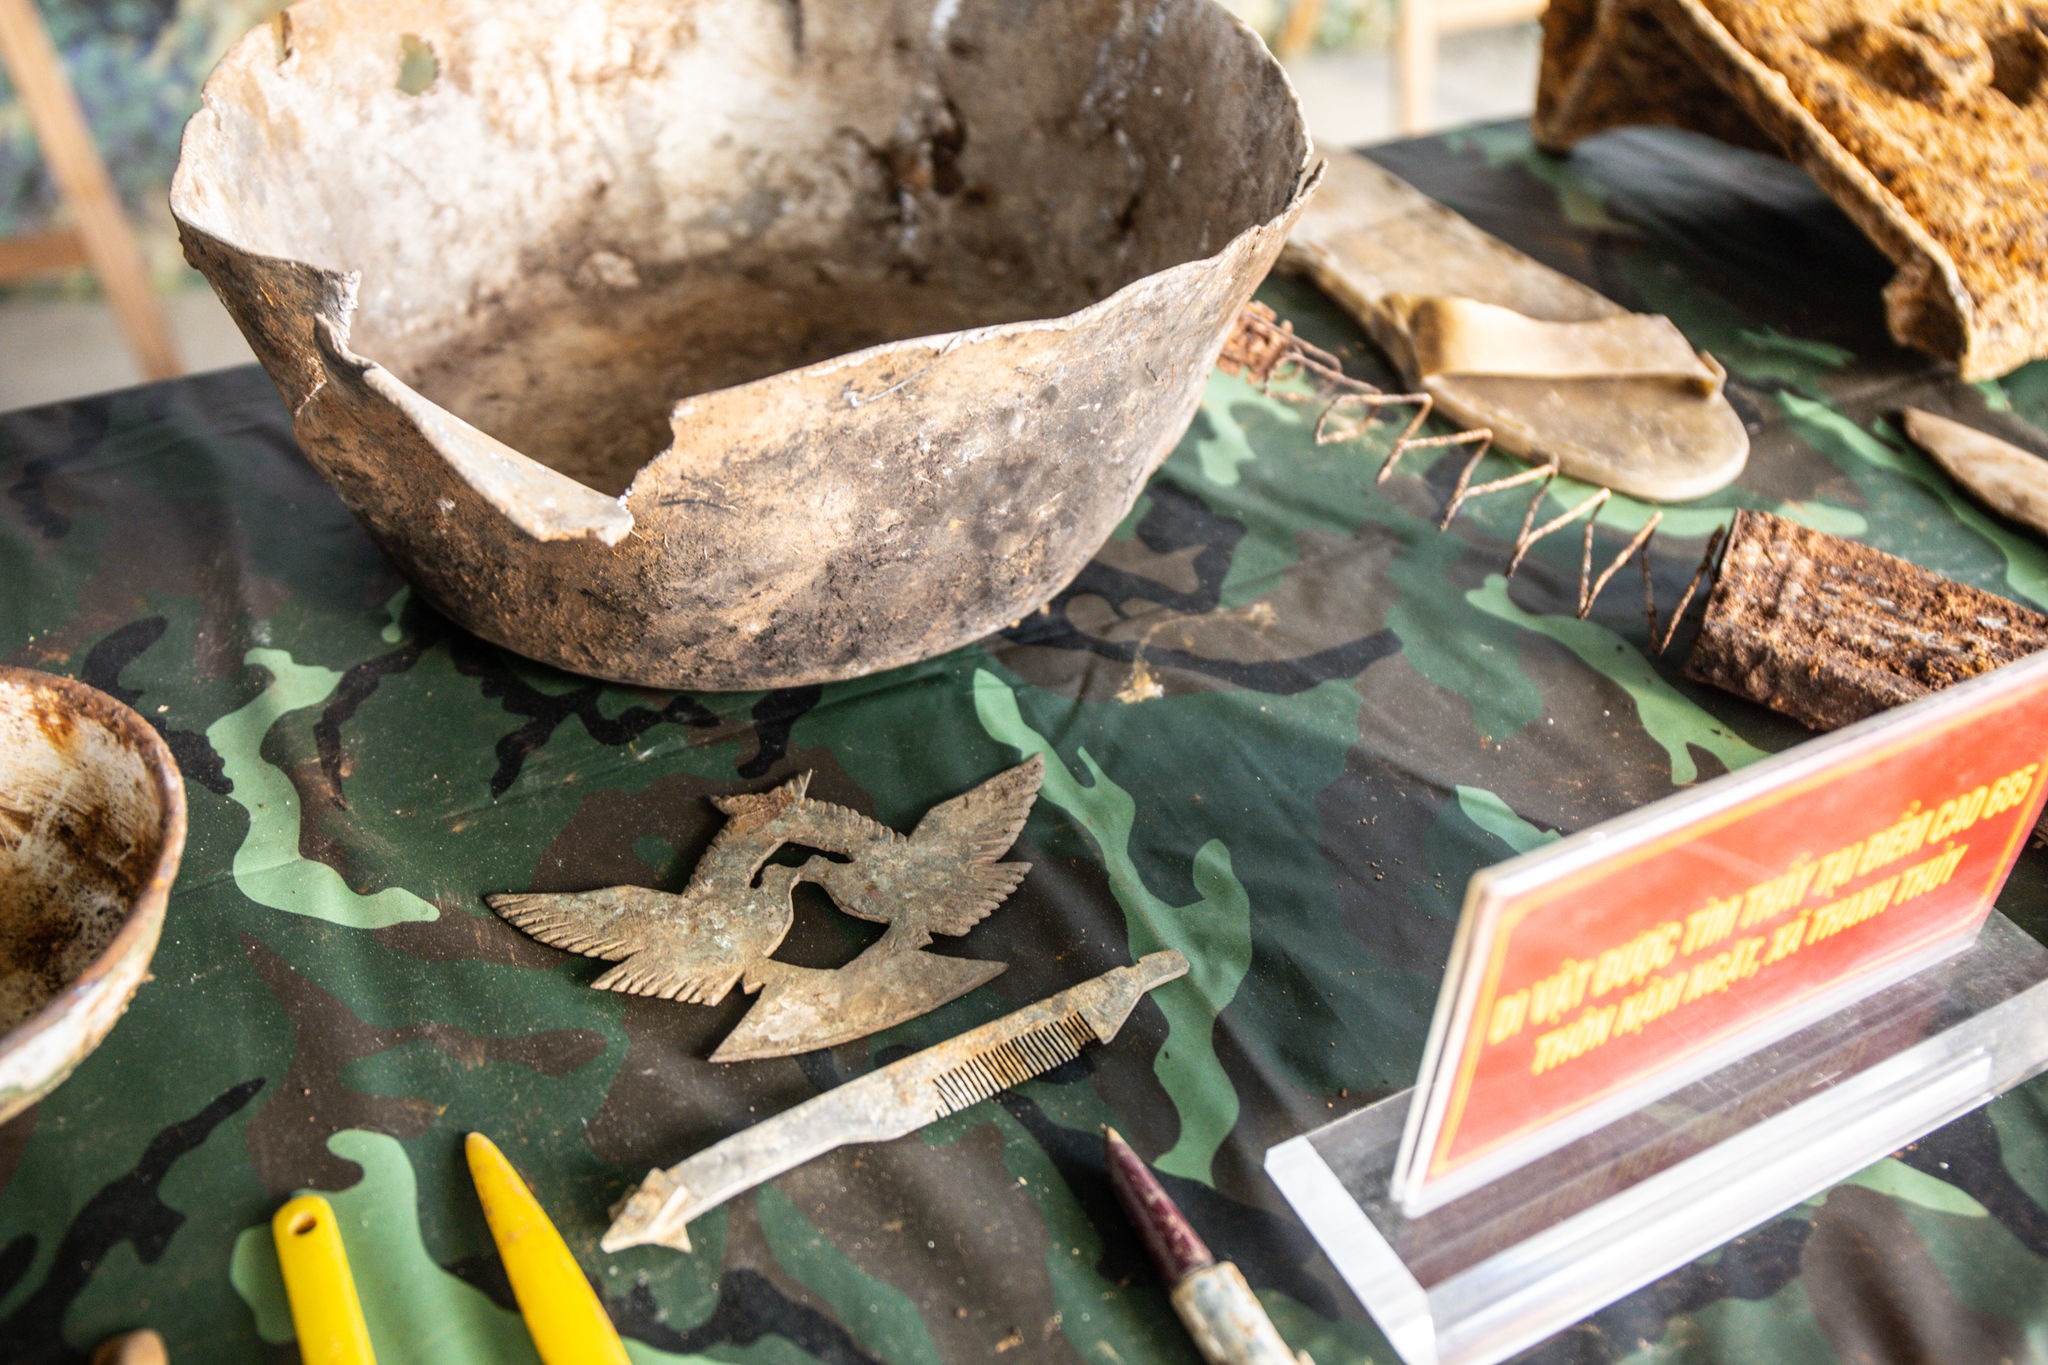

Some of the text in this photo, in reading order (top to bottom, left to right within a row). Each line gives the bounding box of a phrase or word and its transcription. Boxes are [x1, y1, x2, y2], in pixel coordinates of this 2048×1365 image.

[1680, 895, 1744, 956] TÌM
[1812, 841, 1865, 898] TẠI
[1926, 786, 1989, 844] CAO
[1980, 763, 2039, 819] 685
